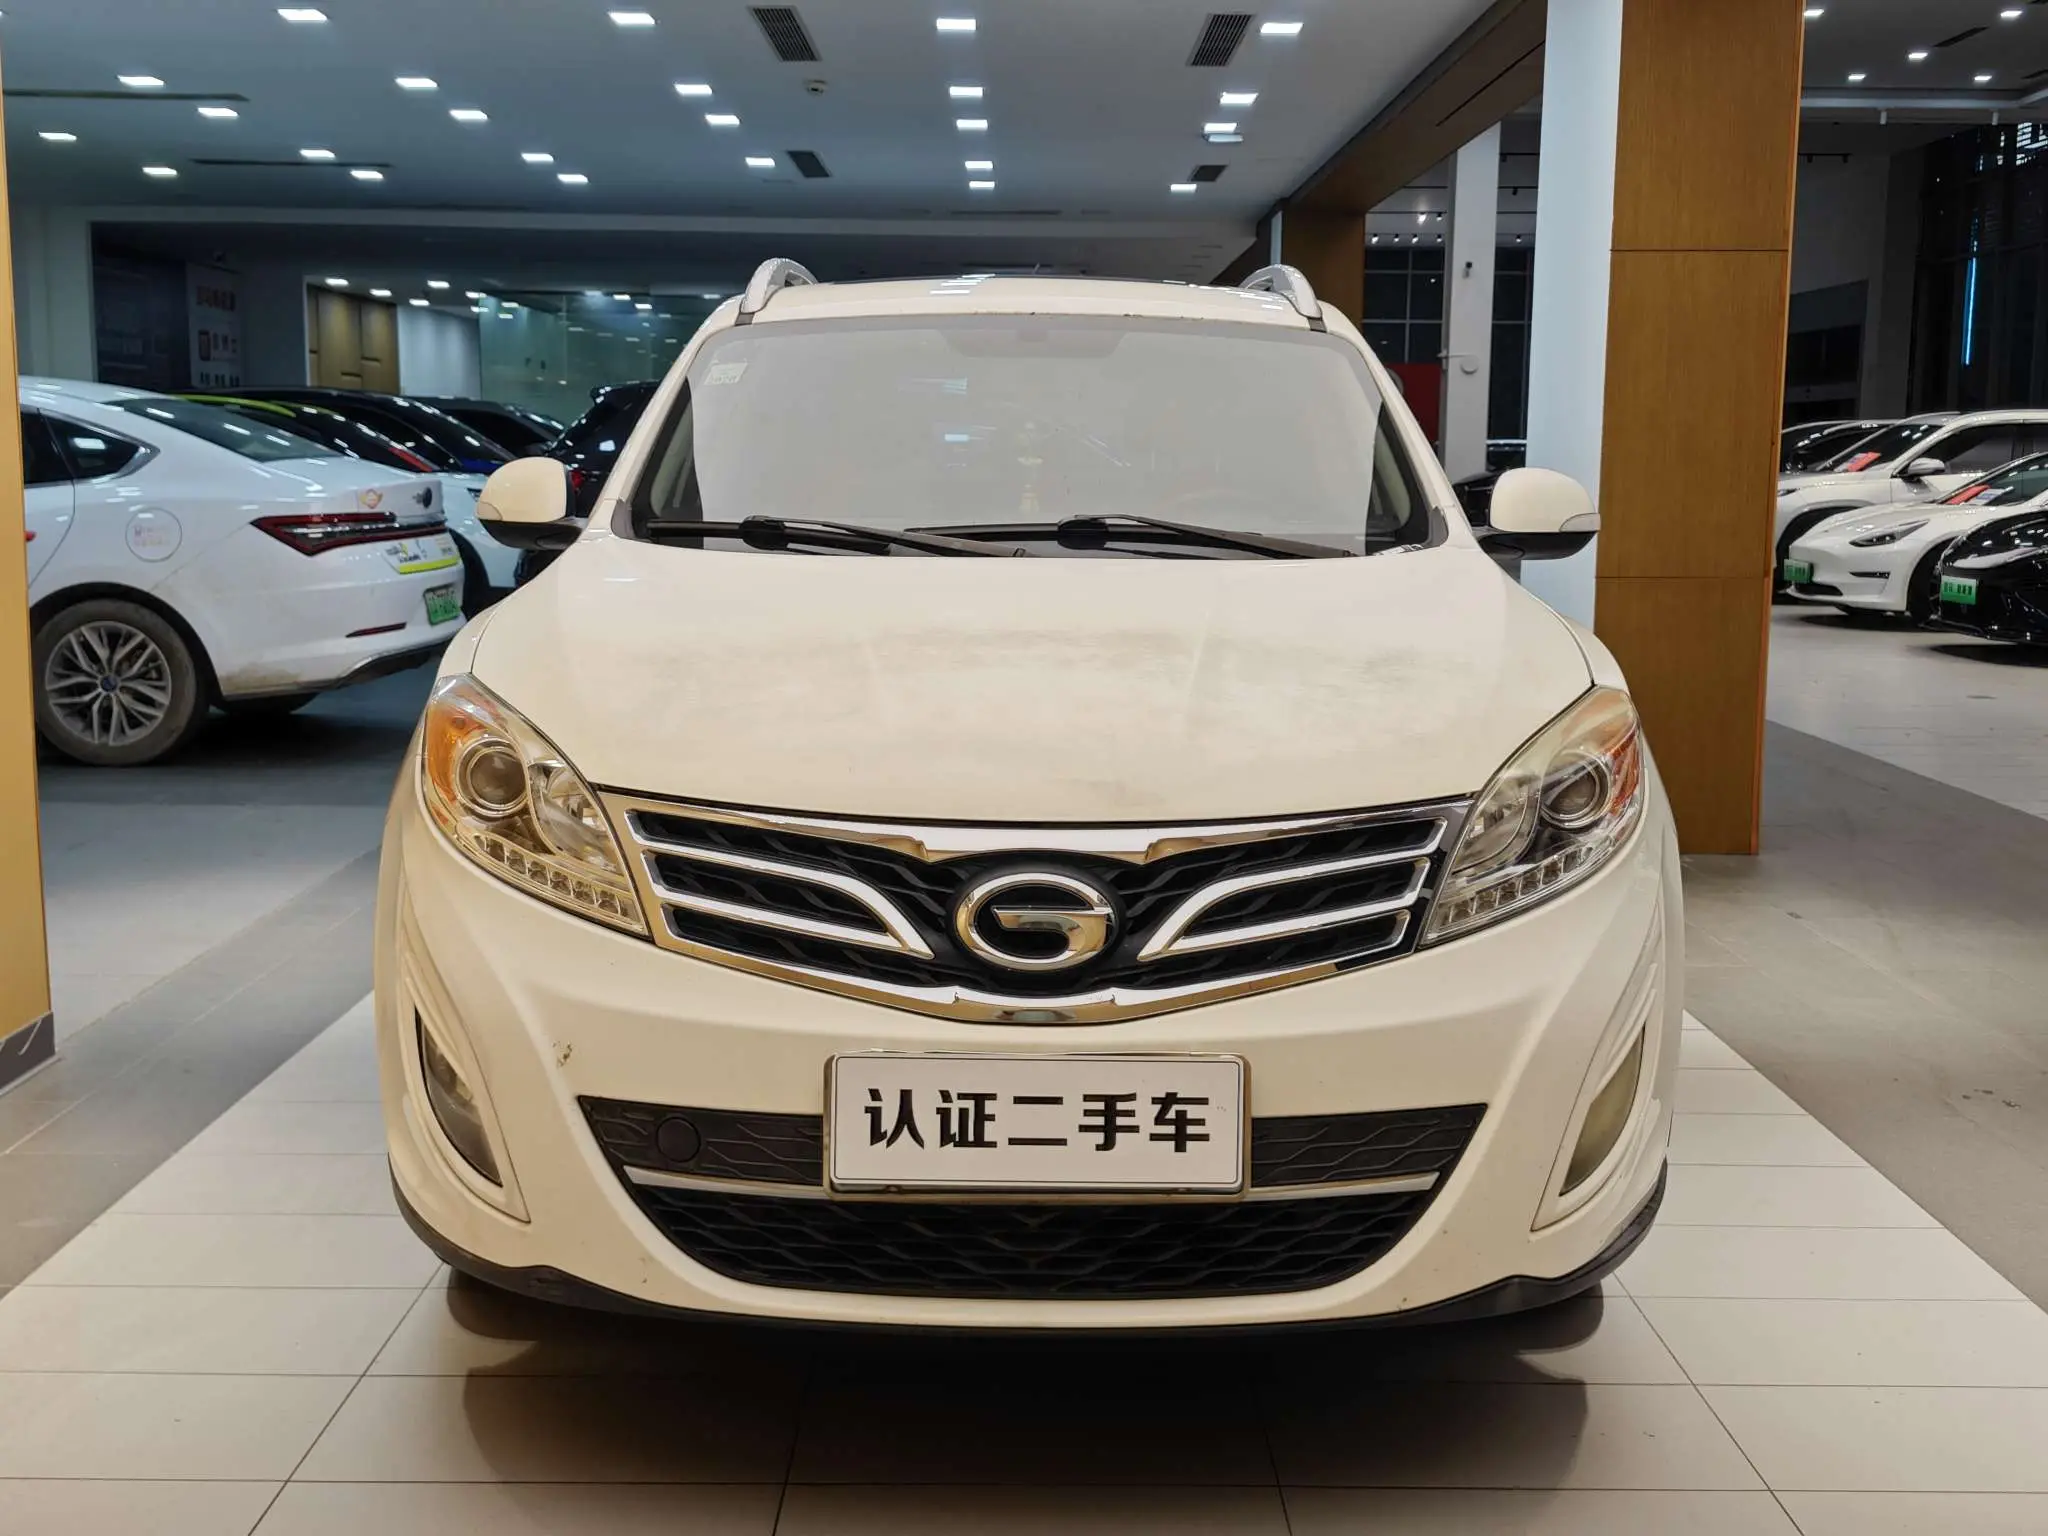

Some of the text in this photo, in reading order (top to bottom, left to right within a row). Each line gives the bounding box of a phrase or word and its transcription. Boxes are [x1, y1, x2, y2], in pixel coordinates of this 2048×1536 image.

[864, 1088, 1210, 1152] 认证二手车
